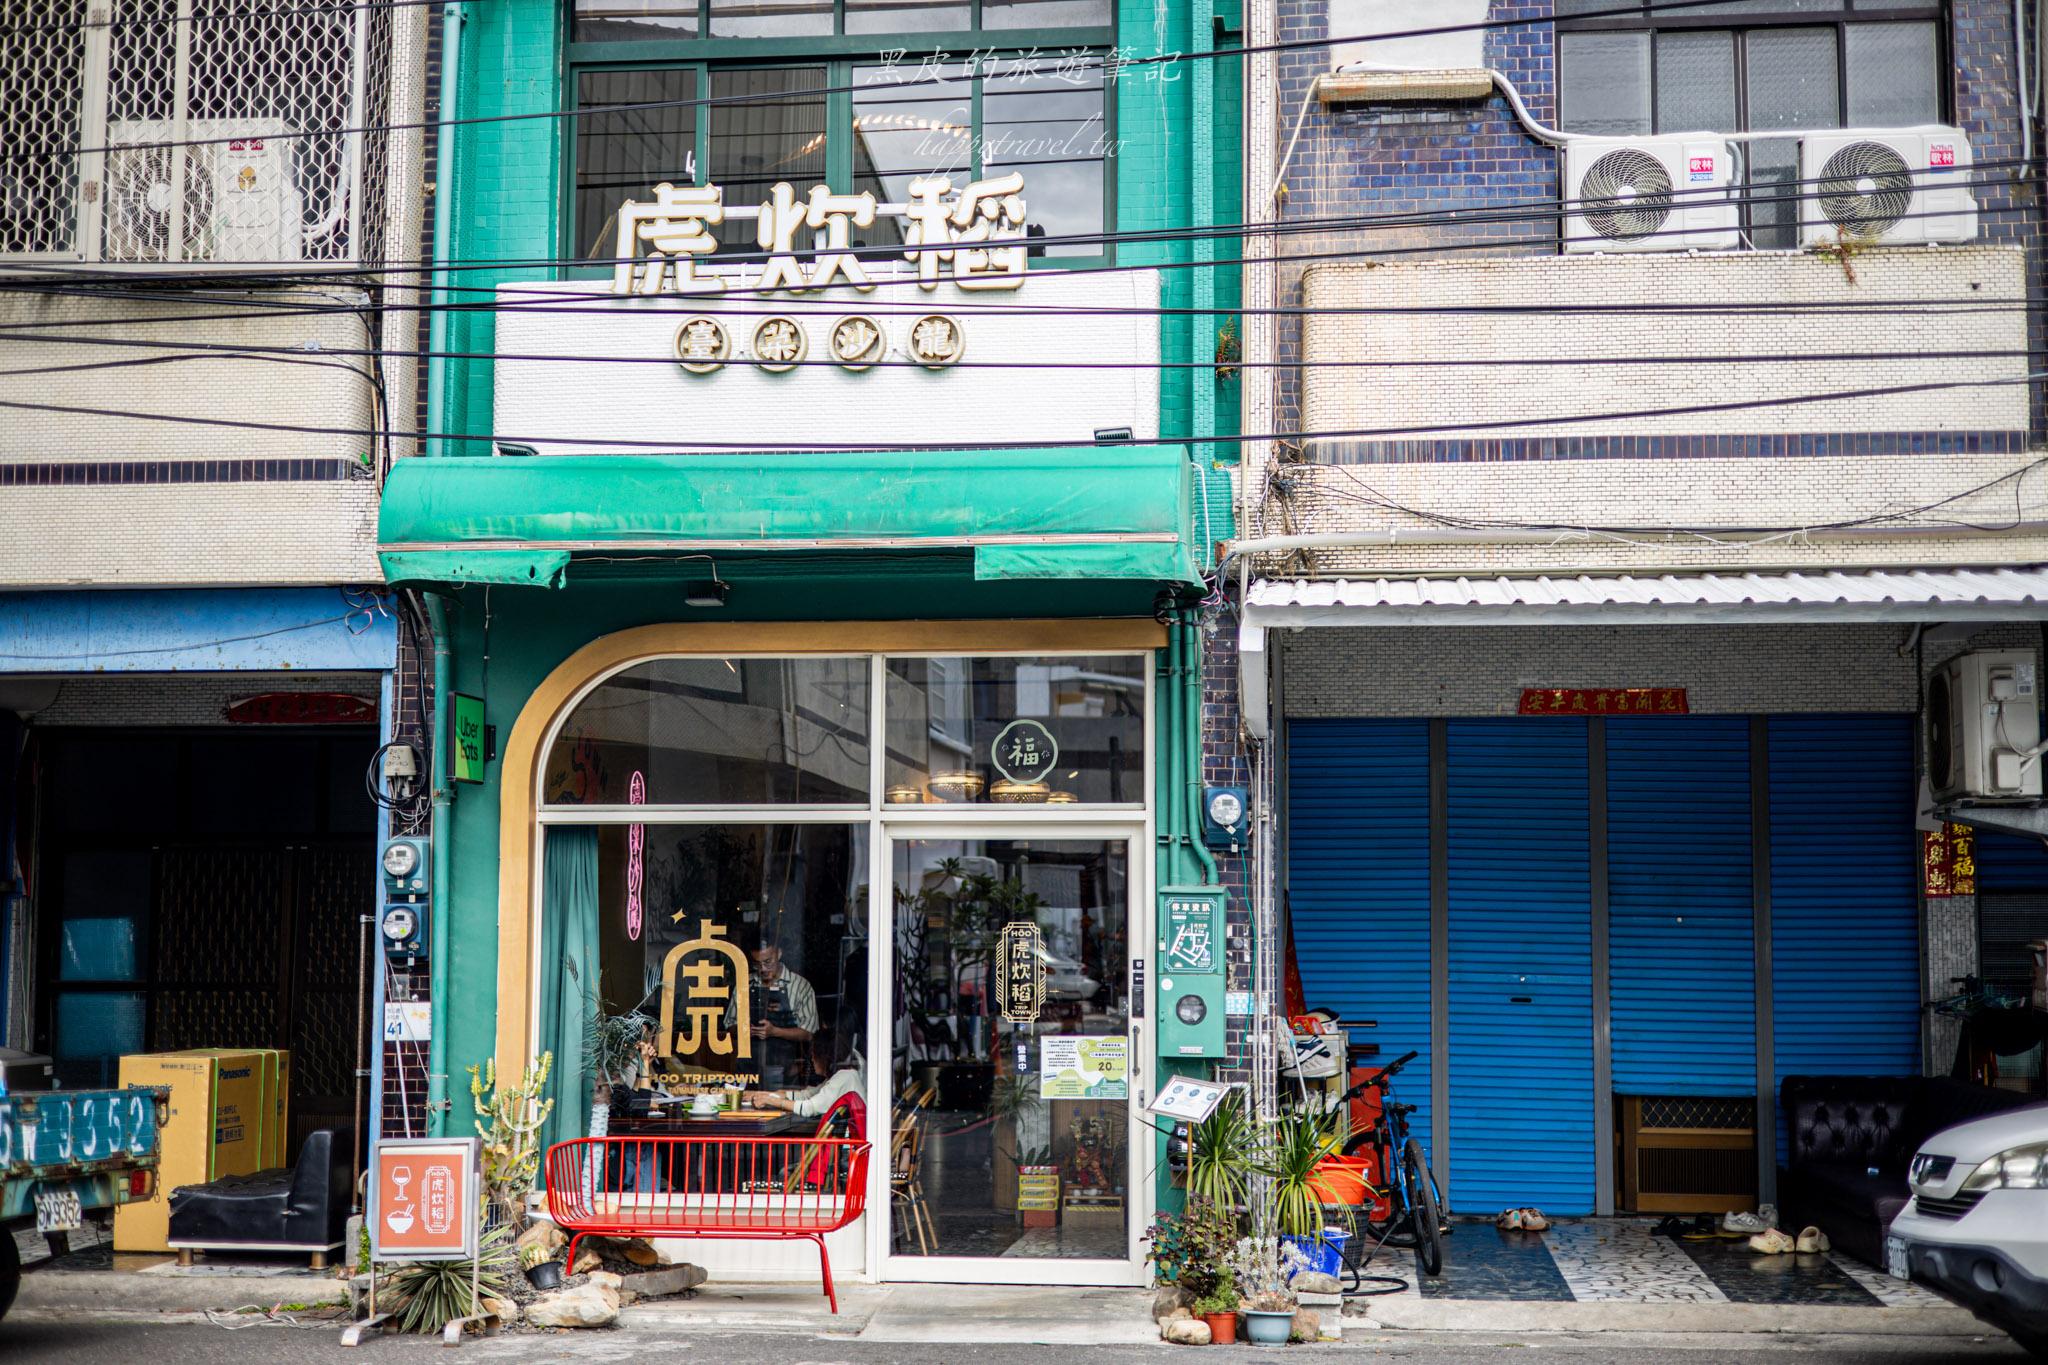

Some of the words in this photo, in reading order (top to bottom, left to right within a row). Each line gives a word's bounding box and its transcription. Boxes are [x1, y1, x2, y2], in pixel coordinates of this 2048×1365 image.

[612, 171, 1027, 296] 虎炊稻
[460, 716, 479, 738] Uber
[460, 739, 479, 761] Eats
[1008, 737, 1039, 767] 福
[1012, 941, 1031, 1002] 虎炊稻
[387, 1022, 402, 1035] 41
[219, 1066, 251, 1080] Panasonic
[1098, 1062, 1112, 1071] 20
[683, 1073, 760, 1084] TRIPTOWN
